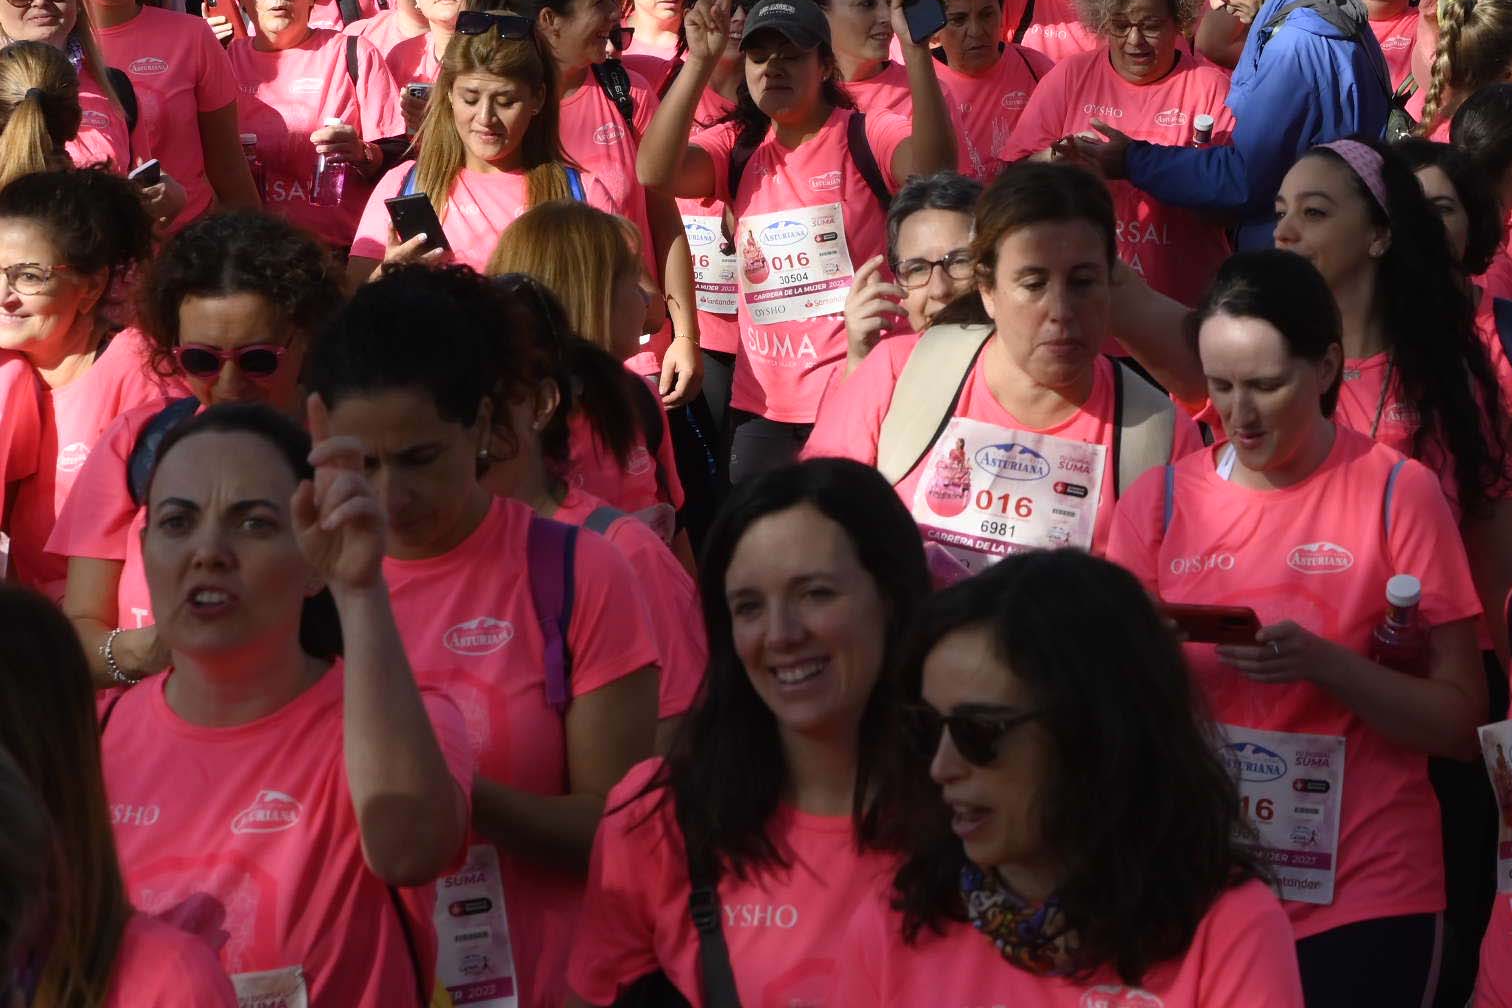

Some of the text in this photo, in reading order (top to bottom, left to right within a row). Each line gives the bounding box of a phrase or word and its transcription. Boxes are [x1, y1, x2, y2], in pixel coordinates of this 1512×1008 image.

[771, 251, 810, 271] 016
[779, 271, 809, 285] 30504
[748, 327, 818, 359] SUMA
[980, 449, 1044, 476] ASTURIANA
[975, 489, 1034, 518] 016
[980, 520, 1016, 538] 6981
[927, 529, 1005, 554] CARRERA DE LA
[1295, 758, 1330, 769] SUMA
[444, 872, 487, 888] SUMA
[721, 904, 798, 929] YSHO
